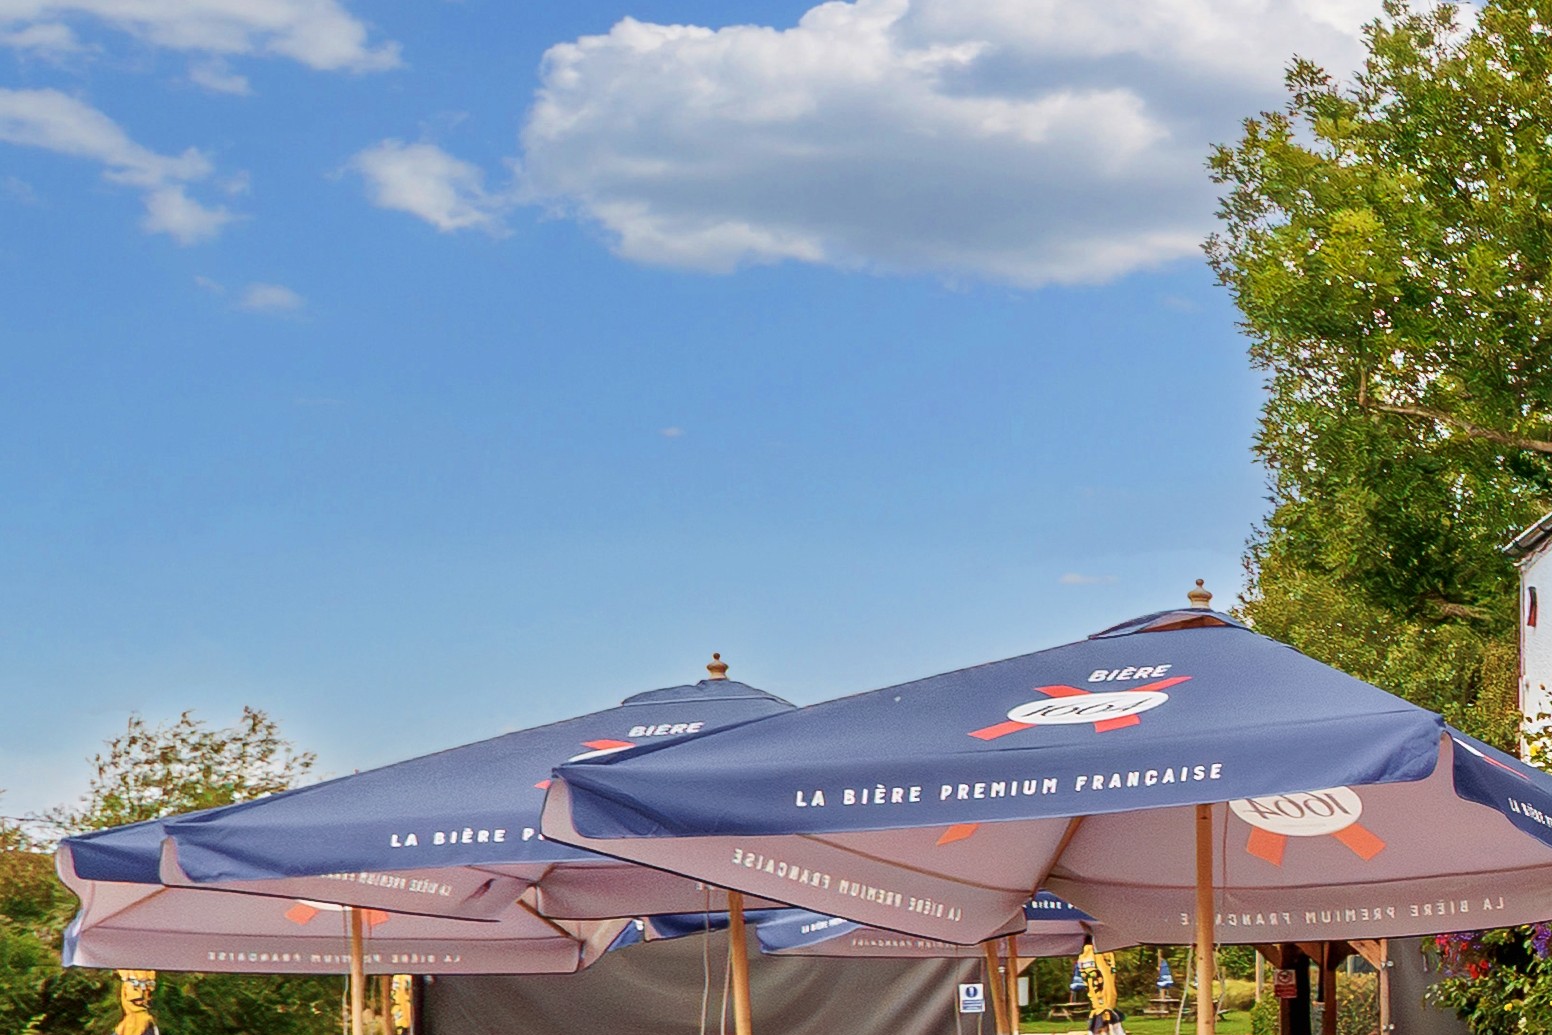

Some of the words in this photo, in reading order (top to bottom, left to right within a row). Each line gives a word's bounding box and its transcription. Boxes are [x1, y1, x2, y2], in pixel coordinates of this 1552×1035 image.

[1087, 664, 1172, 683] BIÈRE
[795, 790, 825, 807] LA
[842, 783, 922, 805] BIÈRE
[940, 777, 1058, 801] PREMIUM
[390, 833, 418, 847] LA
[433, 827, 506, 845] BIÈRE
